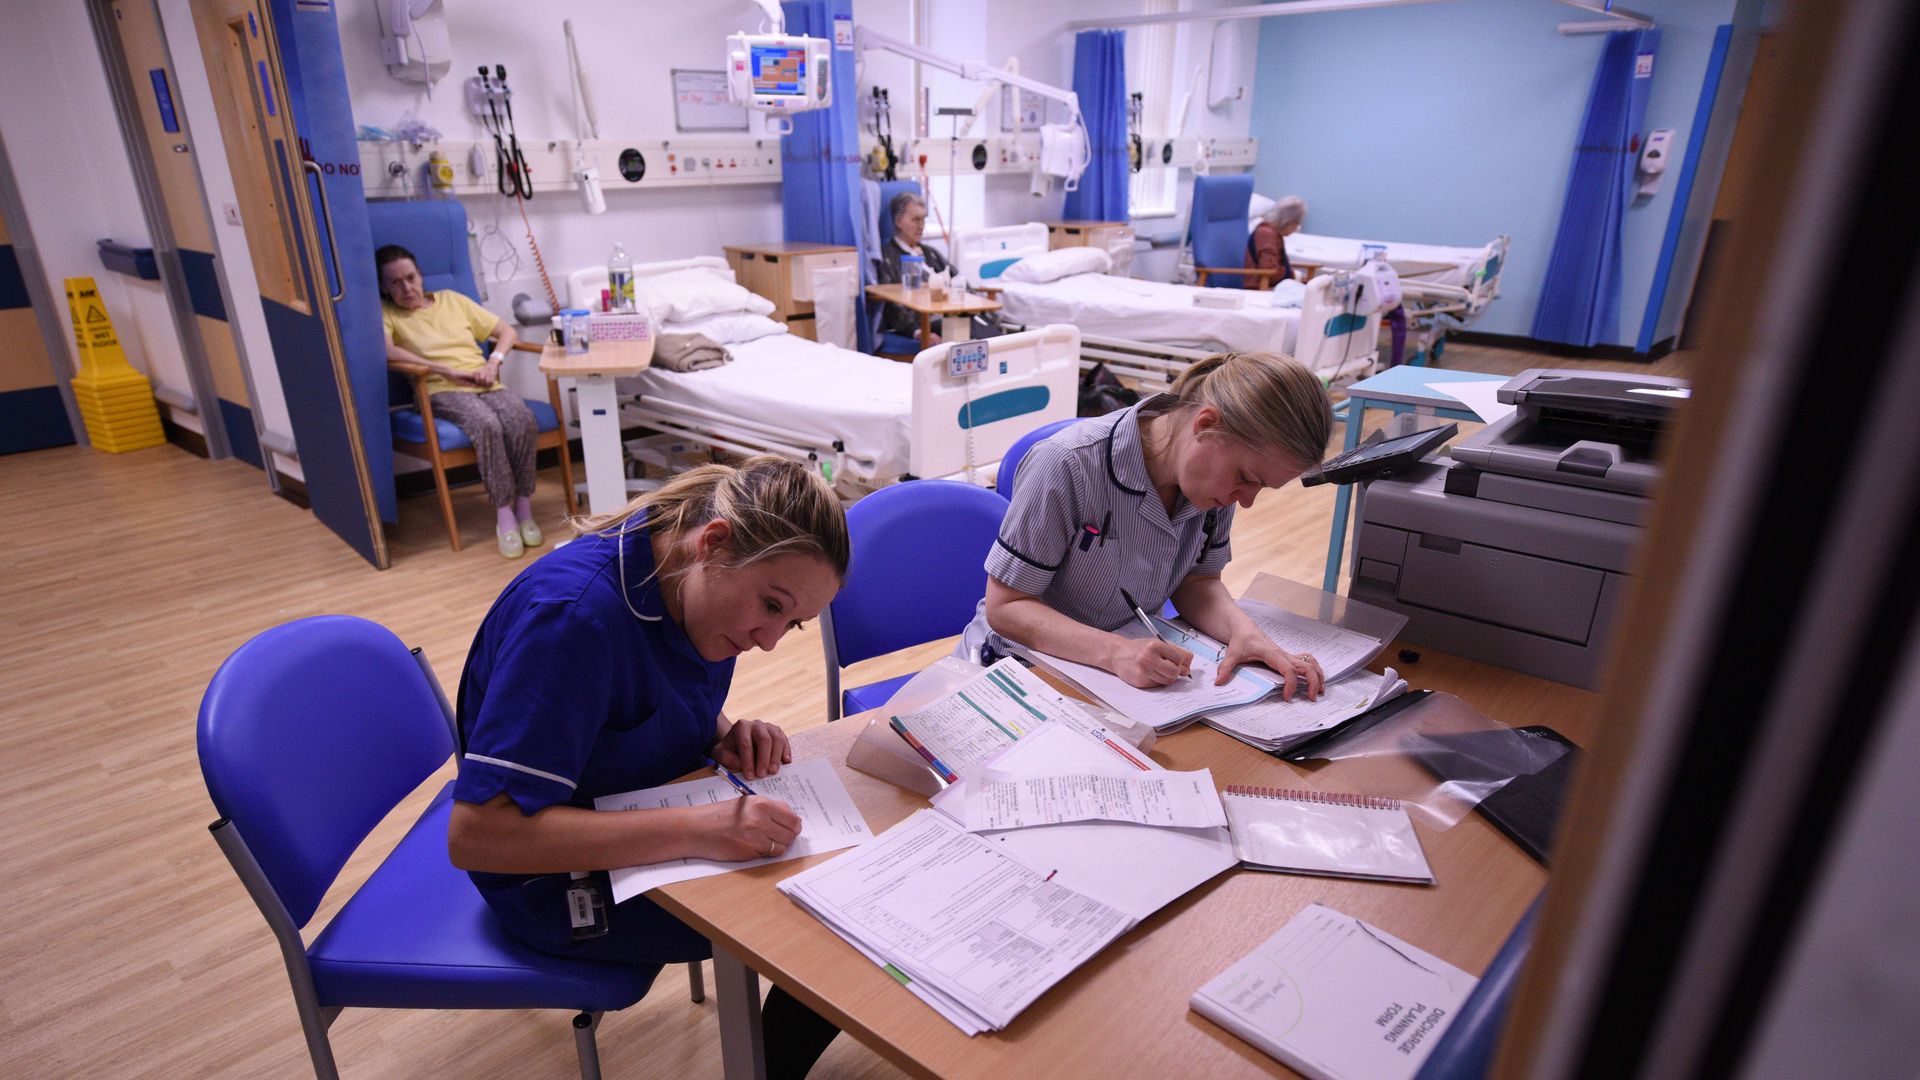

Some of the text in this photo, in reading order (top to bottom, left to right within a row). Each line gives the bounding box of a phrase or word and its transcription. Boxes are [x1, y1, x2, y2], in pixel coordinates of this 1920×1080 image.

[339, 163, 361, 176] NO
[1375, 1002, 1403, 1028] FORM
[1384, 1002, 1427, 1044] PLANNING
[1397, 1007, 1445, 1056] DISCHARGE
